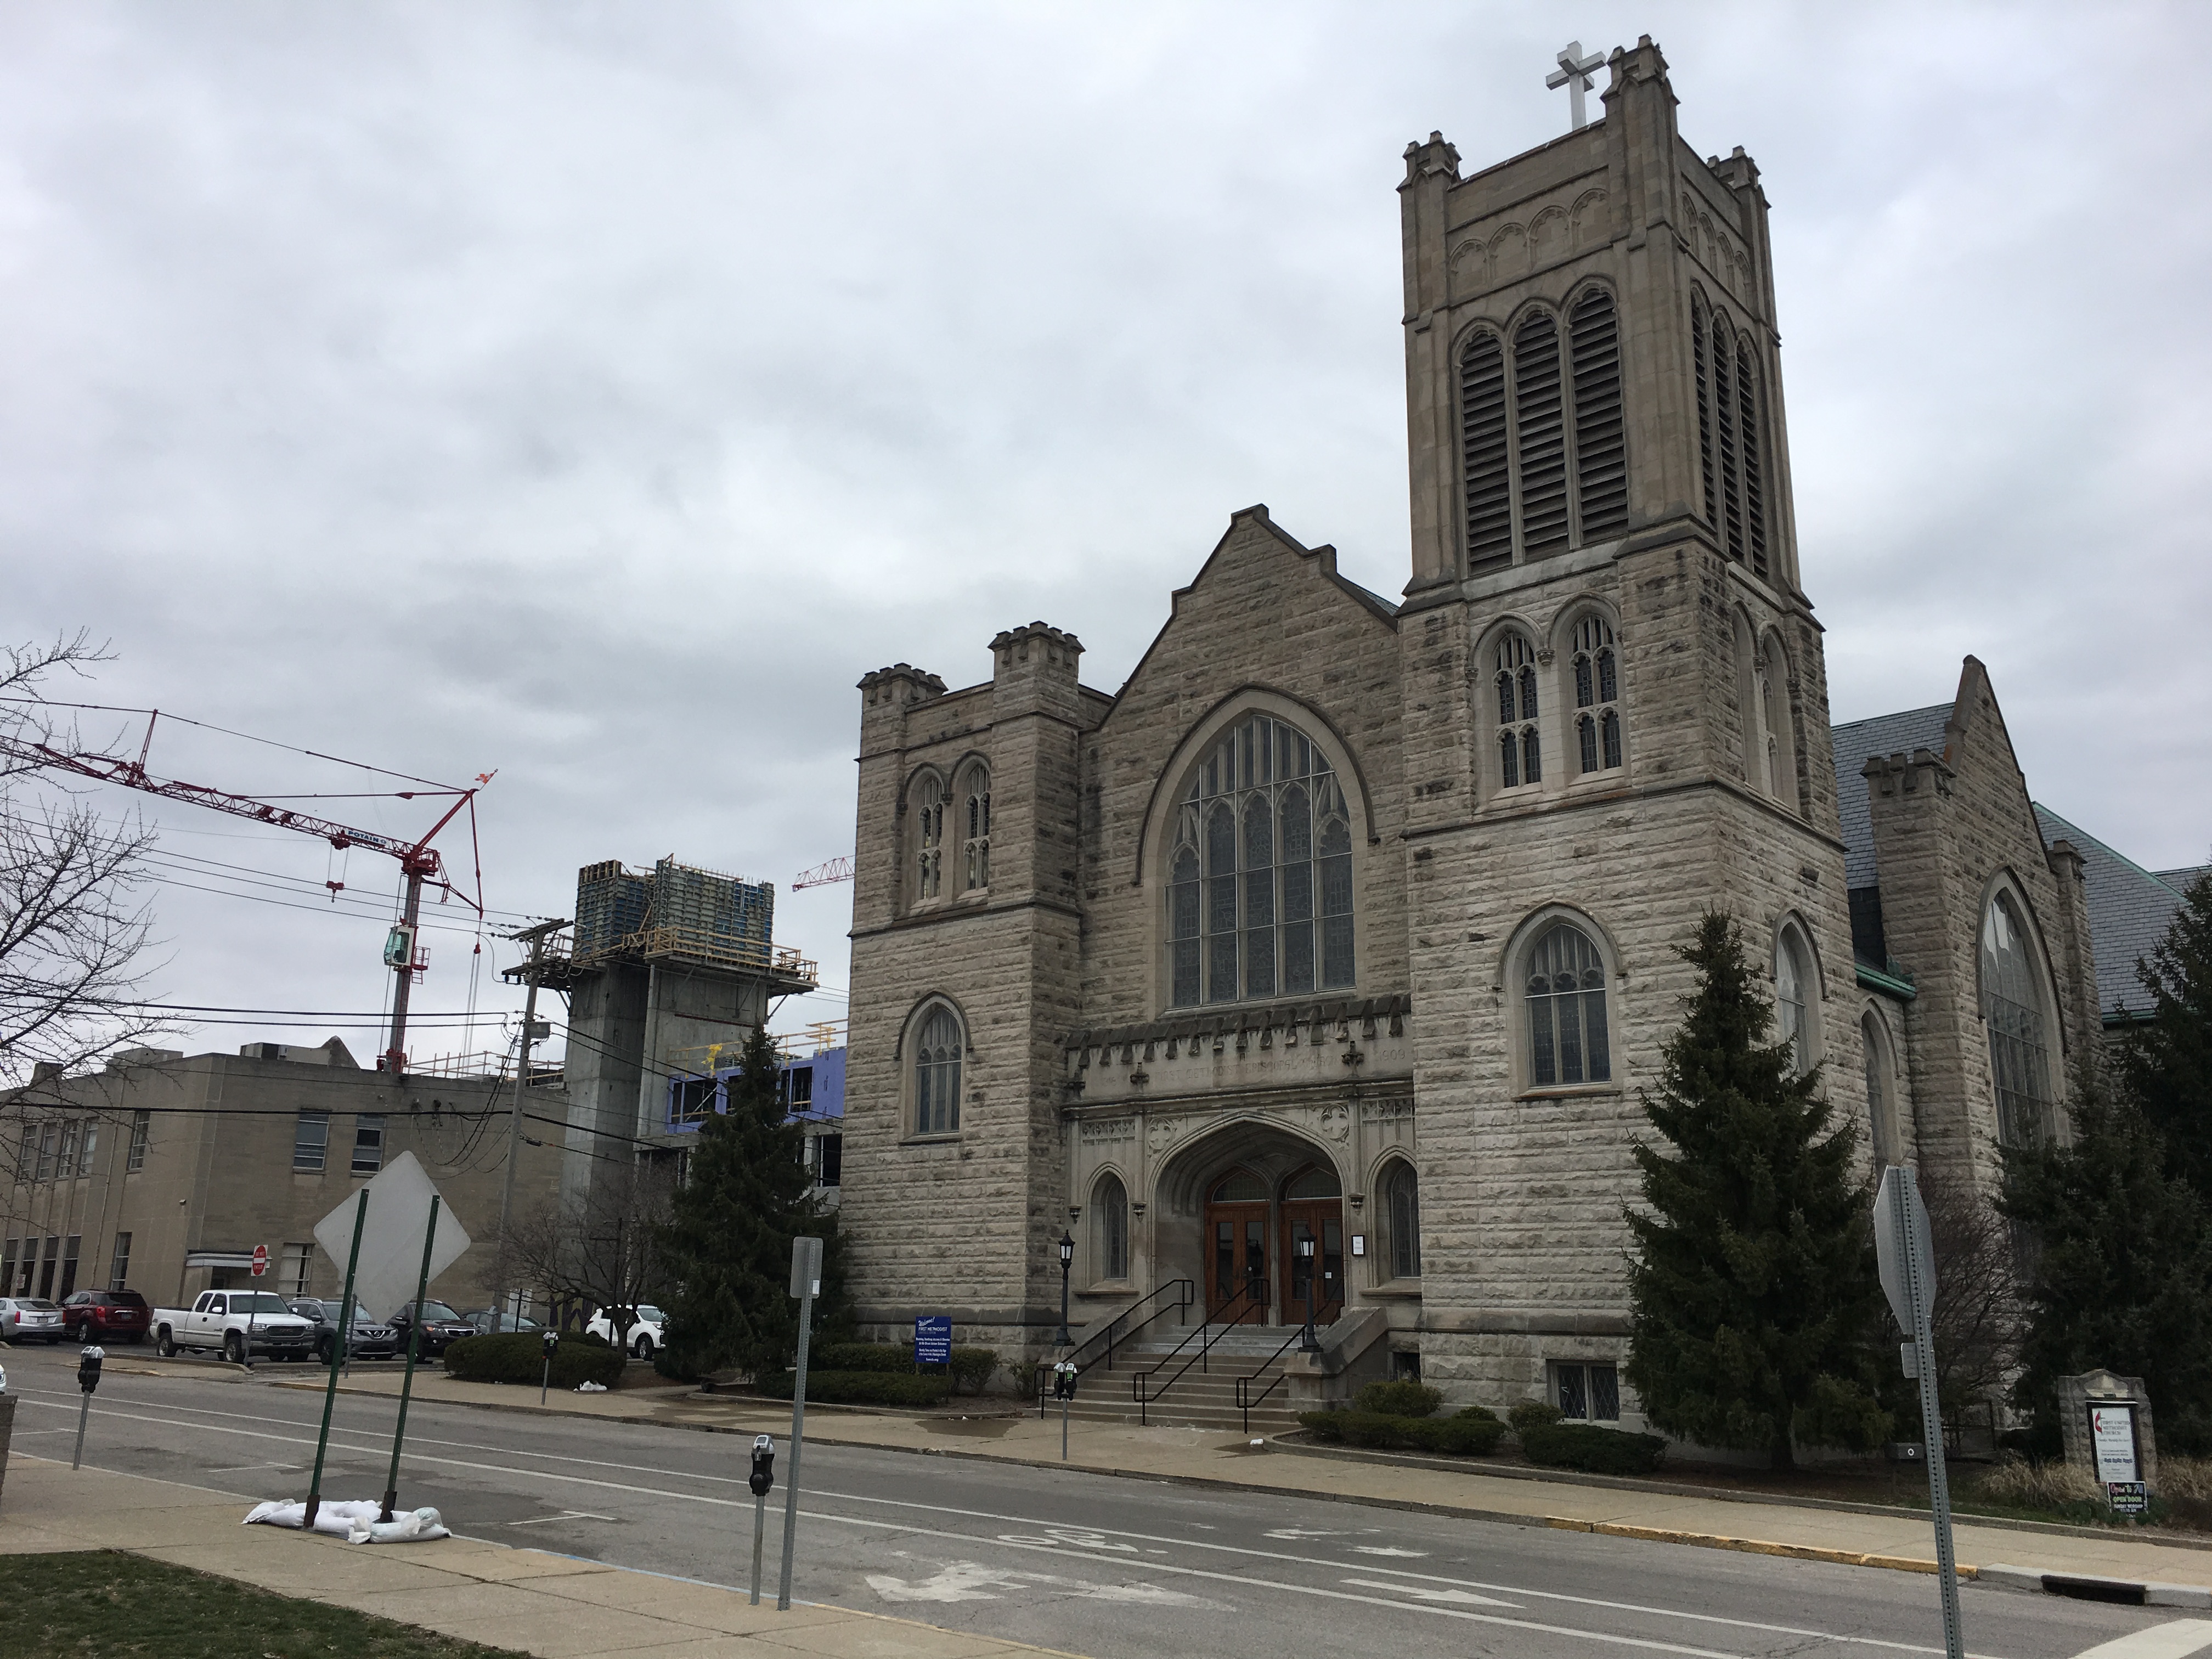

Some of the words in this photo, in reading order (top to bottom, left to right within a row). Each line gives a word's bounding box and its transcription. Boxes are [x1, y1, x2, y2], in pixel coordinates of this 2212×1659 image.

[1380, 1048, 1406, 1062] 1909
[1155, 1069, 1182, 1081] FIRST
[1186, 1064, 1240, 1080] METHODIST
